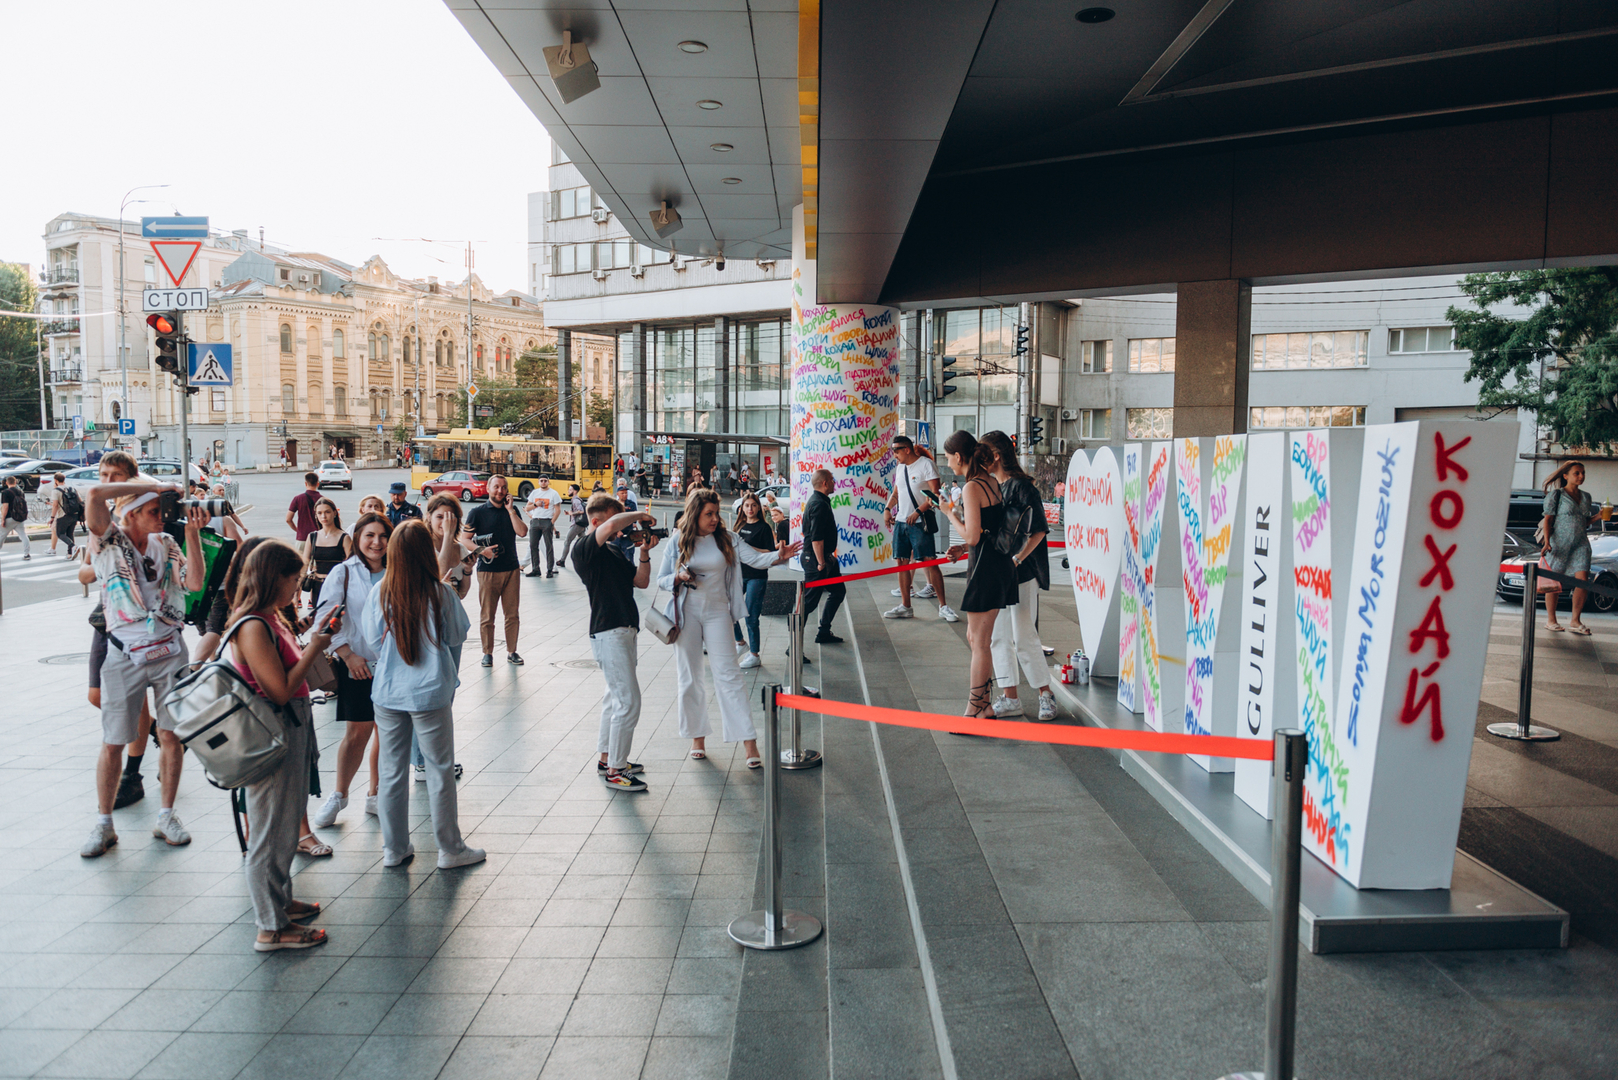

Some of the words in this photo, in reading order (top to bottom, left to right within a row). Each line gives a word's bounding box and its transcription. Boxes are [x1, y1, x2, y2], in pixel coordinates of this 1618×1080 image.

[148, 291, 204, 308] СТОП
[802, 305, 827, 319] КОХАЙ
[802, 309, 837, 336] БОРИСЯ
[831, 309, 866, 332] ДІЛИСЯ
[863, 310, 892, 330] КОХАЙ
[797, 334, 828, 353] ТВОРИ
[825, 340, 856, 355] КОХАЙ
[832, 328, 868, 345] ГОВОРИ
[856, 325, 897, 348] НАДИХАЙ
[804, 351, 840, 371] ГОВОРИ
[797, 372, 843, 392] НАДИХАЙ
[795, 388, 821, 403] КОХАЙ
[845, 394, 875, 418] ТВОРИ
[862, 391, 893, 411] ГОВОРИ
[123, 421, 132, 433] P
[815, 415, 857, 434] КОХАЙ
[857, 416, 871, 428] ВІР
[839, 425, 879, 449] ЦІЛУЙ
[833, 444, 871, 468] КОХАЙ
[1185, 438, 1199, 469] ВІР
[1214, 435, 1233, 467] ДІЙ
[1306, 432, 1328, 474] ВІР
[846, 462, 872, 477] МРІЙ
[1212, 440, 1245, 489] ТВОРИ
[853, 486, 864, 496] ВІР
[1069, 472, 1113, 507] НАПОВНЮЙ
[1210, 485, 1227, 525] ВІР
[848, 513, 879, 532] ГОВОРИ
[1177, 479, 1202, 555] ГОВОРИ
[1296, 496, 1331, 552] ТВОРИ
[868, 532, 884, 549] ВІР
[1086, 526, 1110, 556] ЖИТТЯ
[1204, 523, 1231, 567] ТВОРИ
[1075, 566, 1106, 601] СЕНСАМИ
[1294, 565, 1332, 600] КОХАЙ
[1400, 430, 1473, 742] КОХАЙ
[1247, 504, 1271, 736] GULLIVER
[146, 646, 169, 660] MARVEL
